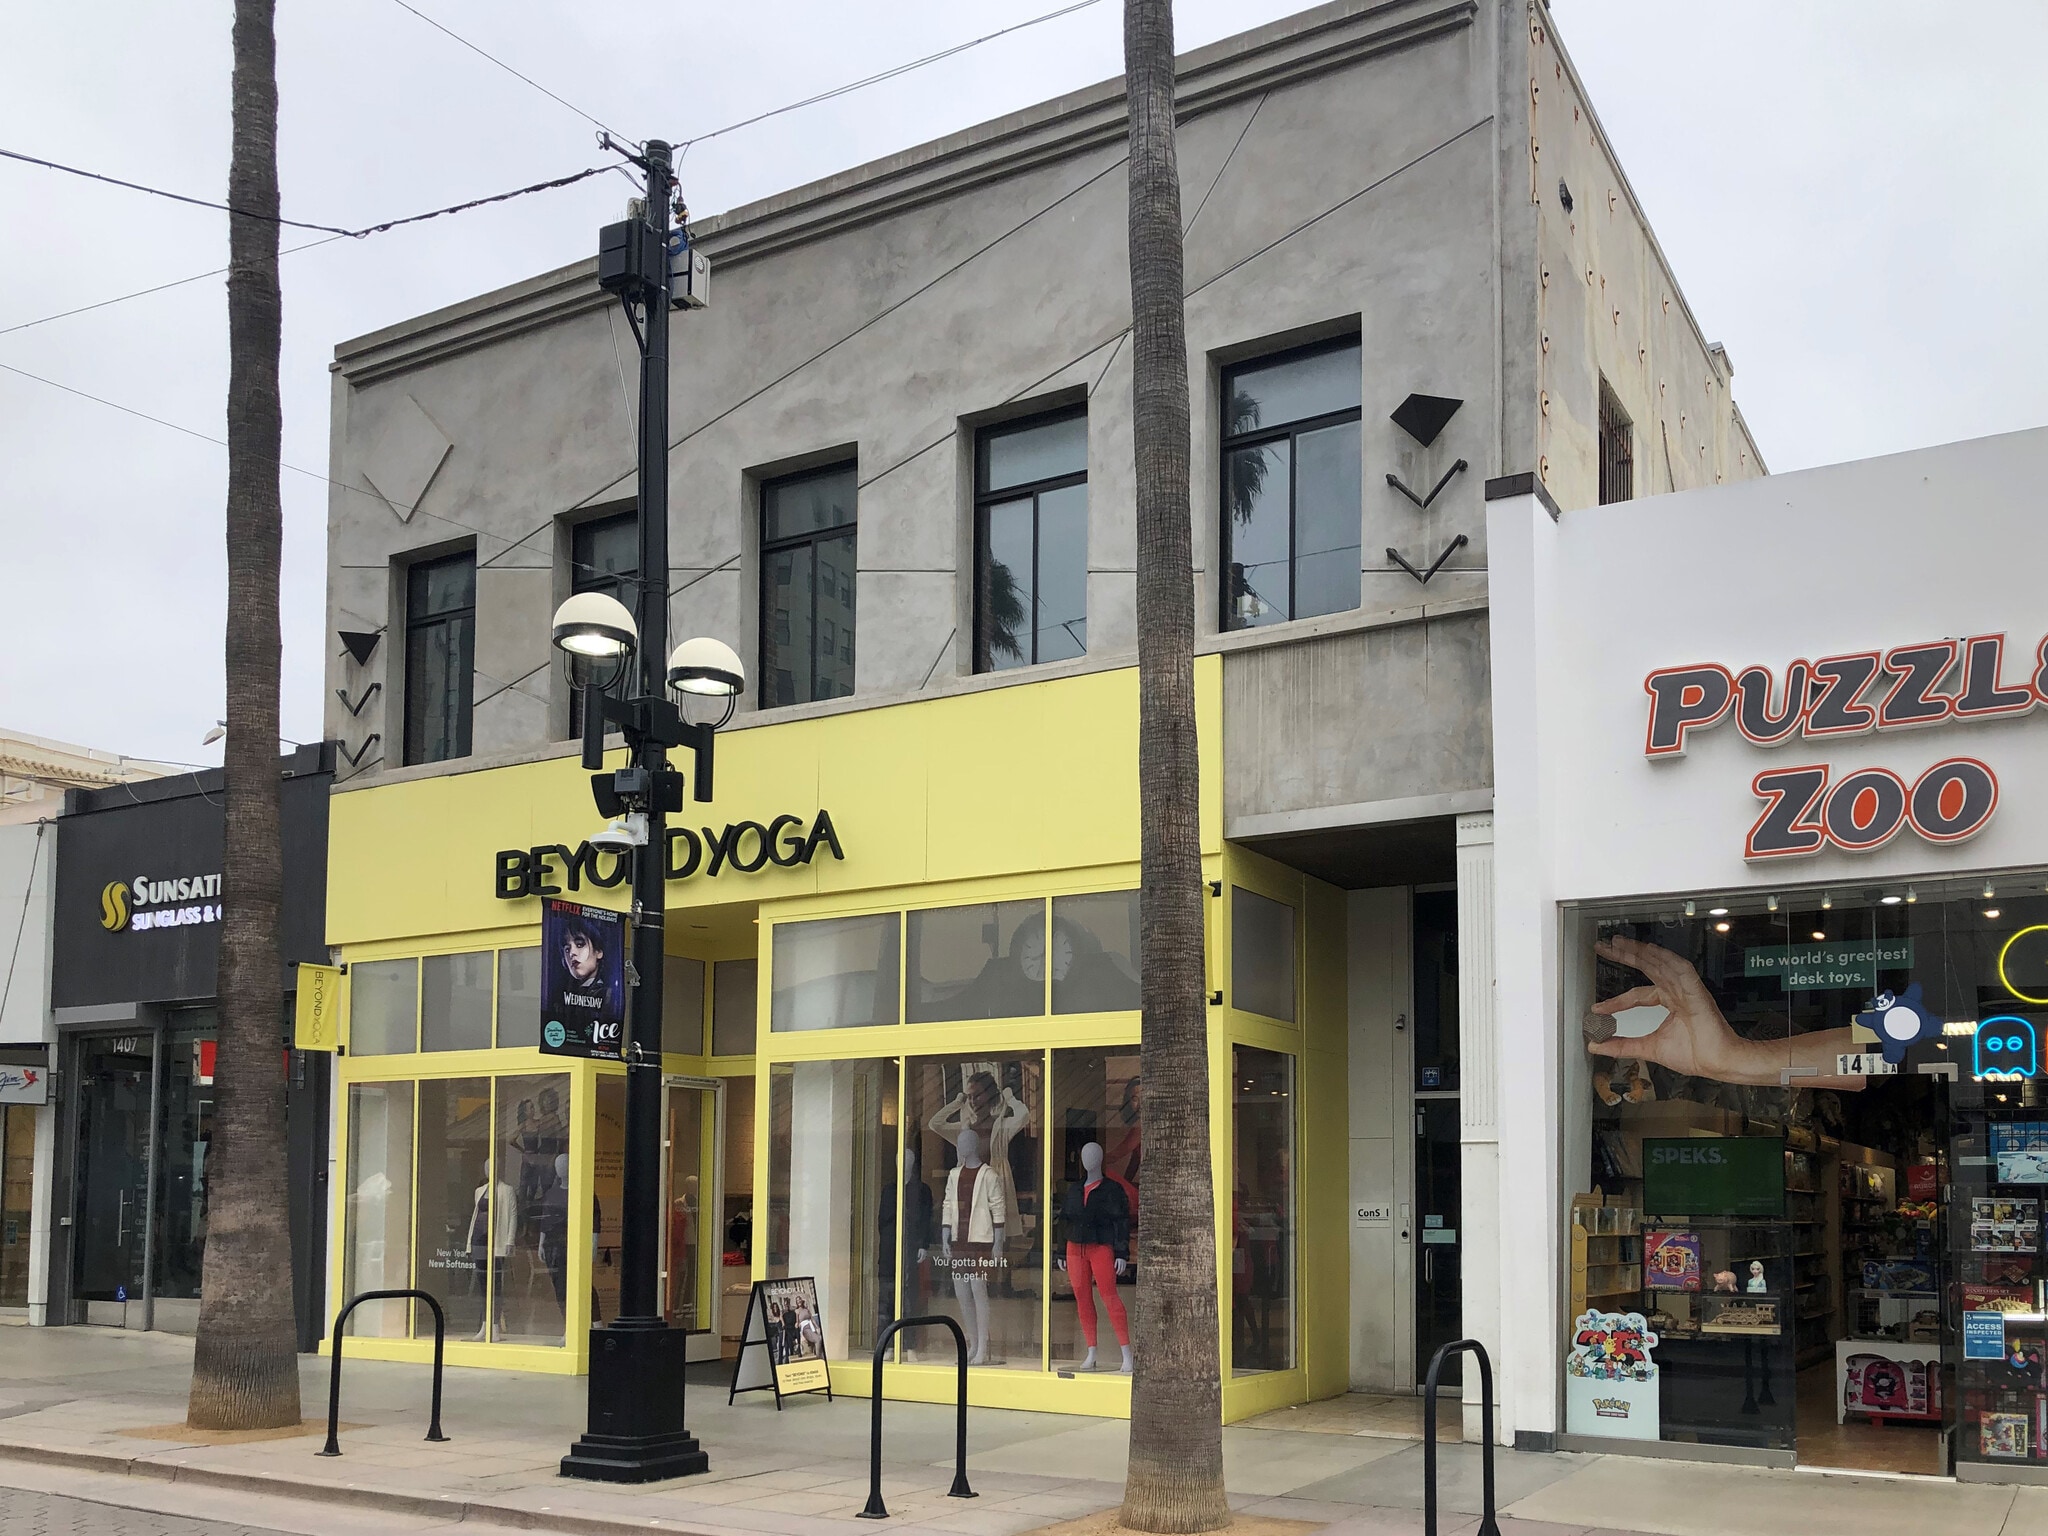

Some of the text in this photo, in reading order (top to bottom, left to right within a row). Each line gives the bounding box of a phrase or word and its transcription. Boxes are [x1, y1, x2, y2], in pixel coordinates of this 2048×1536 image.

[1644, 631, 2048, 761] PUZZL
[1743, 756, 1999, 864] ZOO
[496, 809, 844, 899] BEYODYOGA
[133, 874, 221, 906] SUNSATI
[551, 901, 581, 915] NETFLIX
[132, 907, 201, 930] SUNGLASS
[203, 905, 215, 922] &
[1750, 948, 1908, 968] the world's greatest
[1789, 971, 1865, 986] desk toys.
[593, 1020, 620, 1044] Ice
[113, 1037, 138, 1053] 1407
[436, 1248, 451, 1257] New
[429, 1259, 476, 1269] New Softness
[933, 1256, 1007, 1269] You gotta feel it
[952, 1271, 987, 1282] to get it
